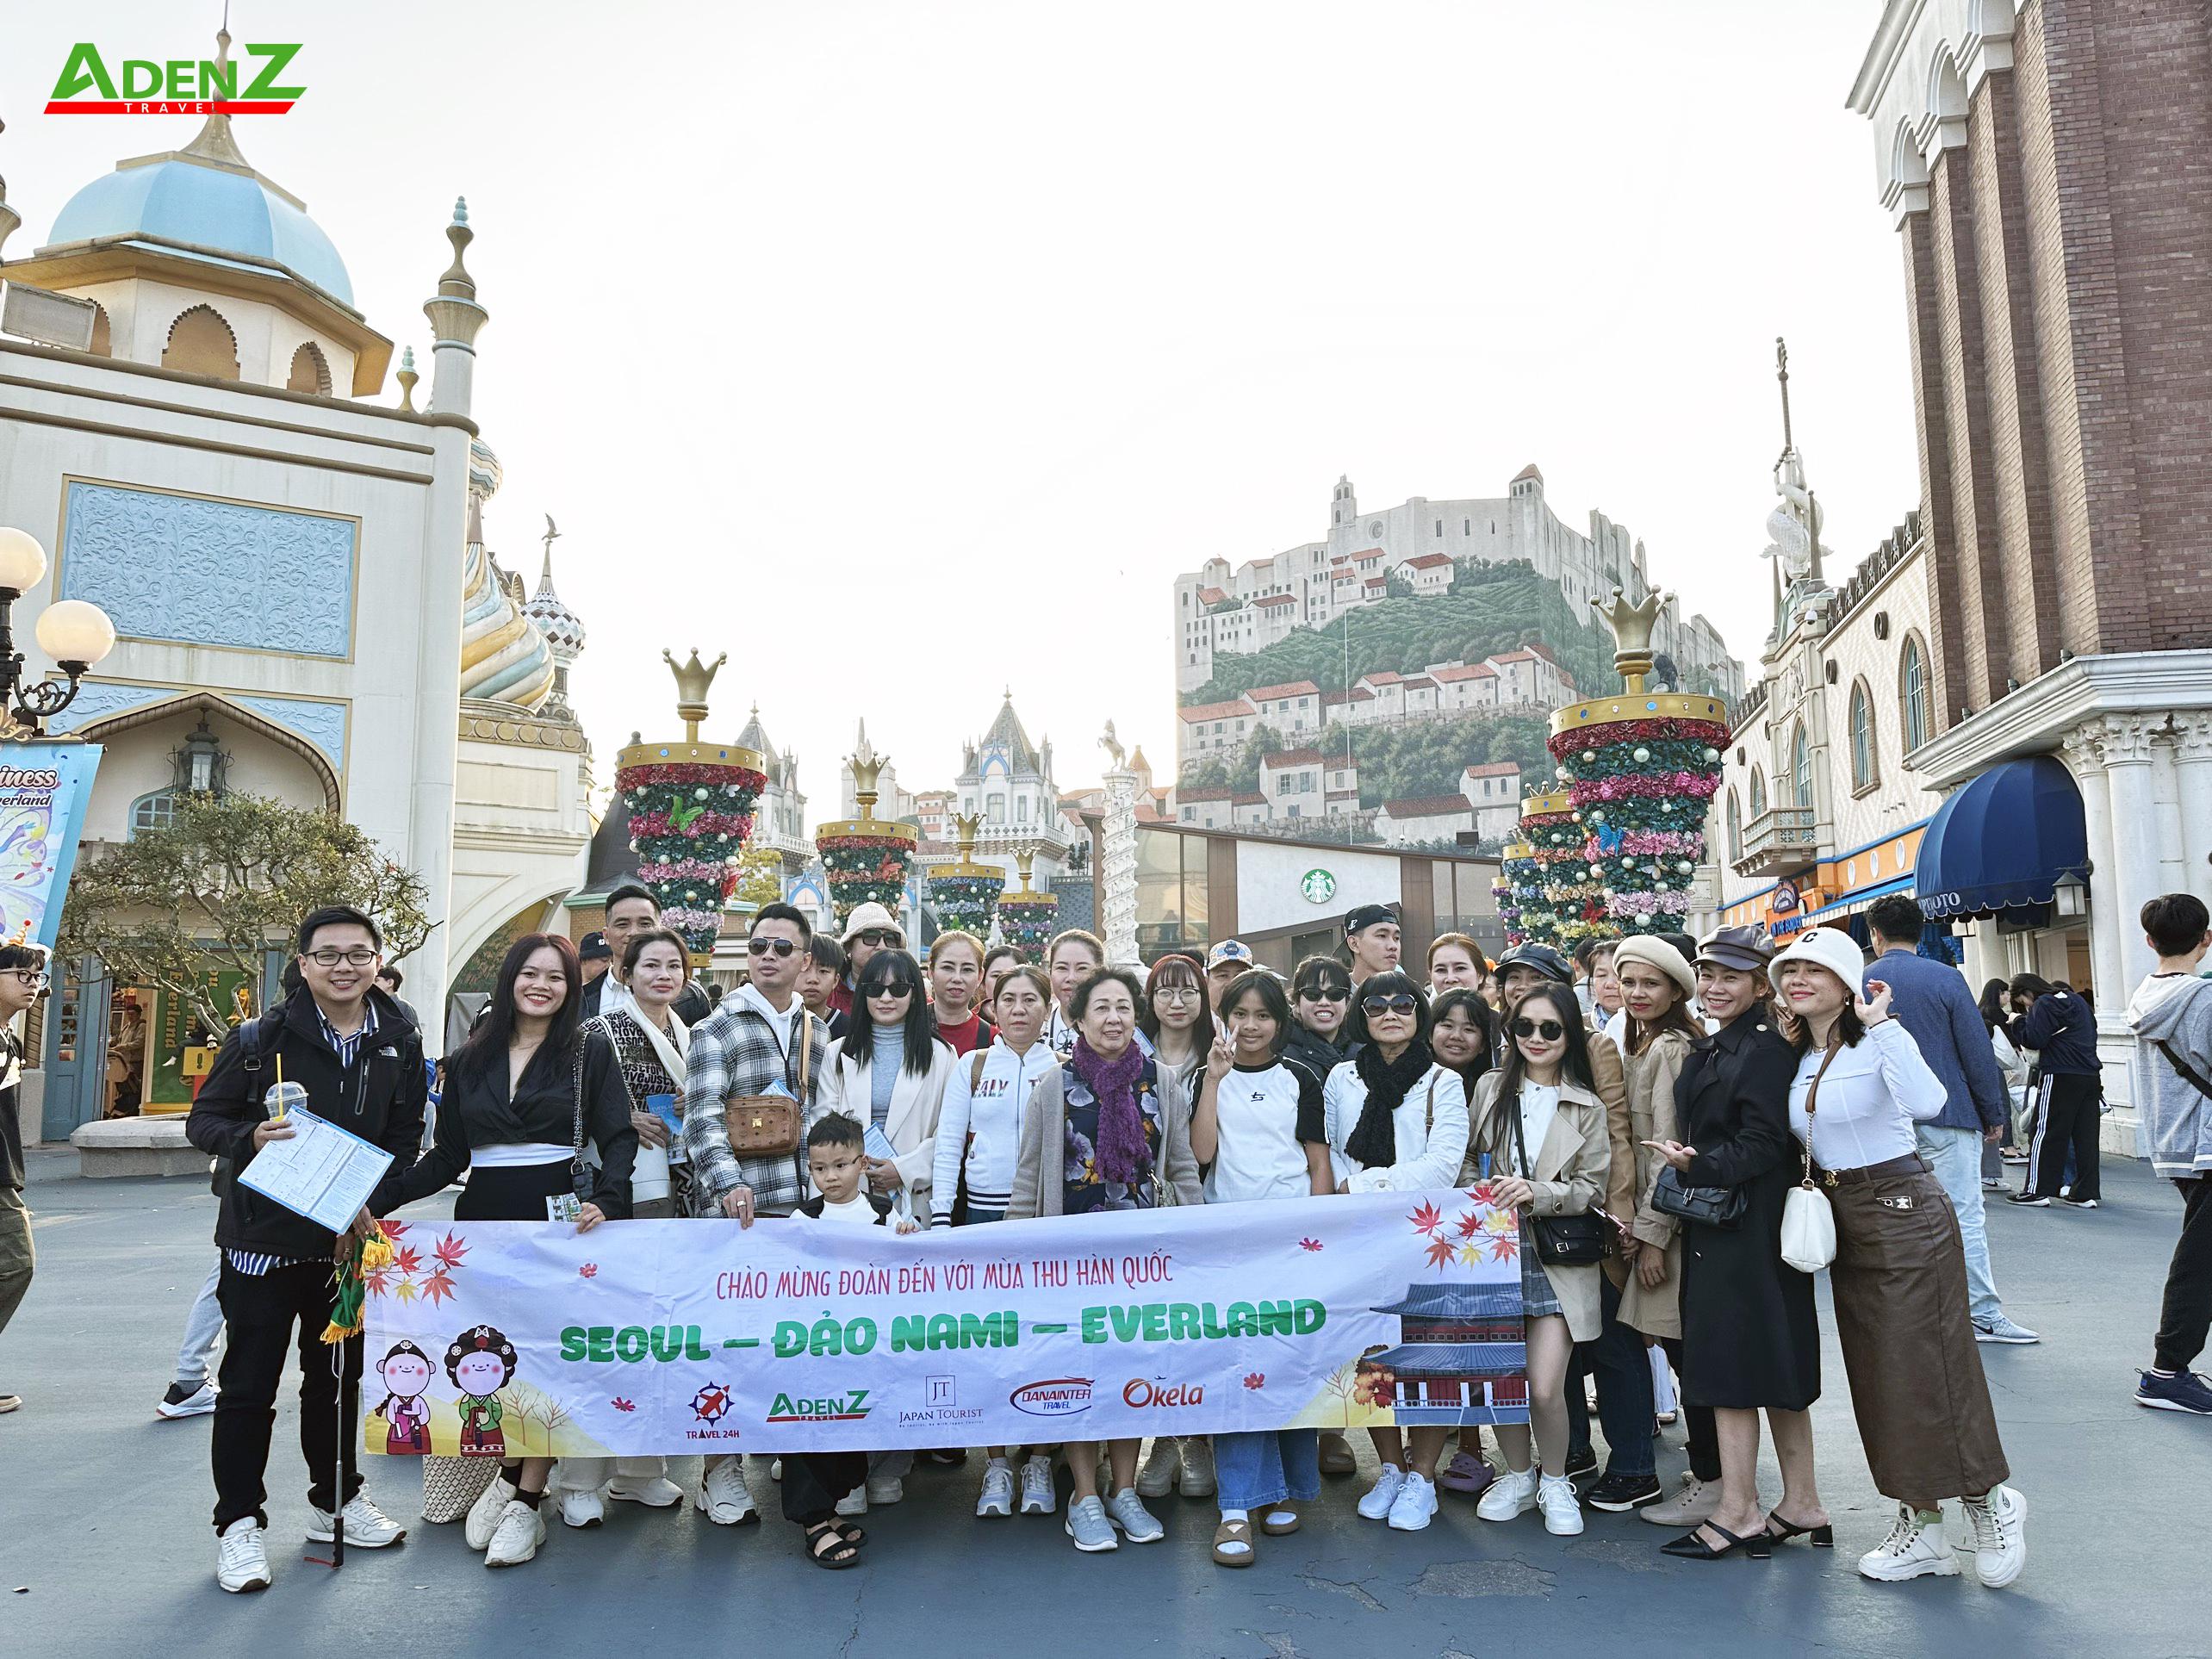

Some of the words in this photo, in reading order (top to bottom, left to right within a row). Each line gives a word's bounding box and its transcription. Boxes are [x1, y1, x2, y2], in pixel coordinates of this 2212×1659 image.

[0, 794, 52, 806] erland
[165, 971, 183, 1049] Eerland
[717, 1264, 768, 1300] CHÀO
[775, 1264, 831, 1298] MỪNG
[838, 1262, 891, 1296] ĐOÀN
[898, 1258, 935, 1294] ĐẾN
[943, 1258, 974, 1291] VỚI
[983, 1257, 1024, 1289] MÙA
[1032, 1260, 1068, 1288] THU
[1076, 1253, 1115, 1285] HÀN
[1122, 1247, 1174, 1289] QUỐC
[560, 1324, 711, 1363] SEOUL
[771, 1310, 878, 1358] ĐẢO
[891, 1310, 1019, 1352] NAMI
[1082, 1299, 1327, 1344] EVERLAND
[1022, 1389, 1091, 1402] DANAINTER
[1123, 1378, 1203, 1407] Okela
[1042, 1401, 1072, 1410] TRAVEL
[686, 1428, 721, 1439] TRAVEL
[723, 1430, 739, 1438] 24H
